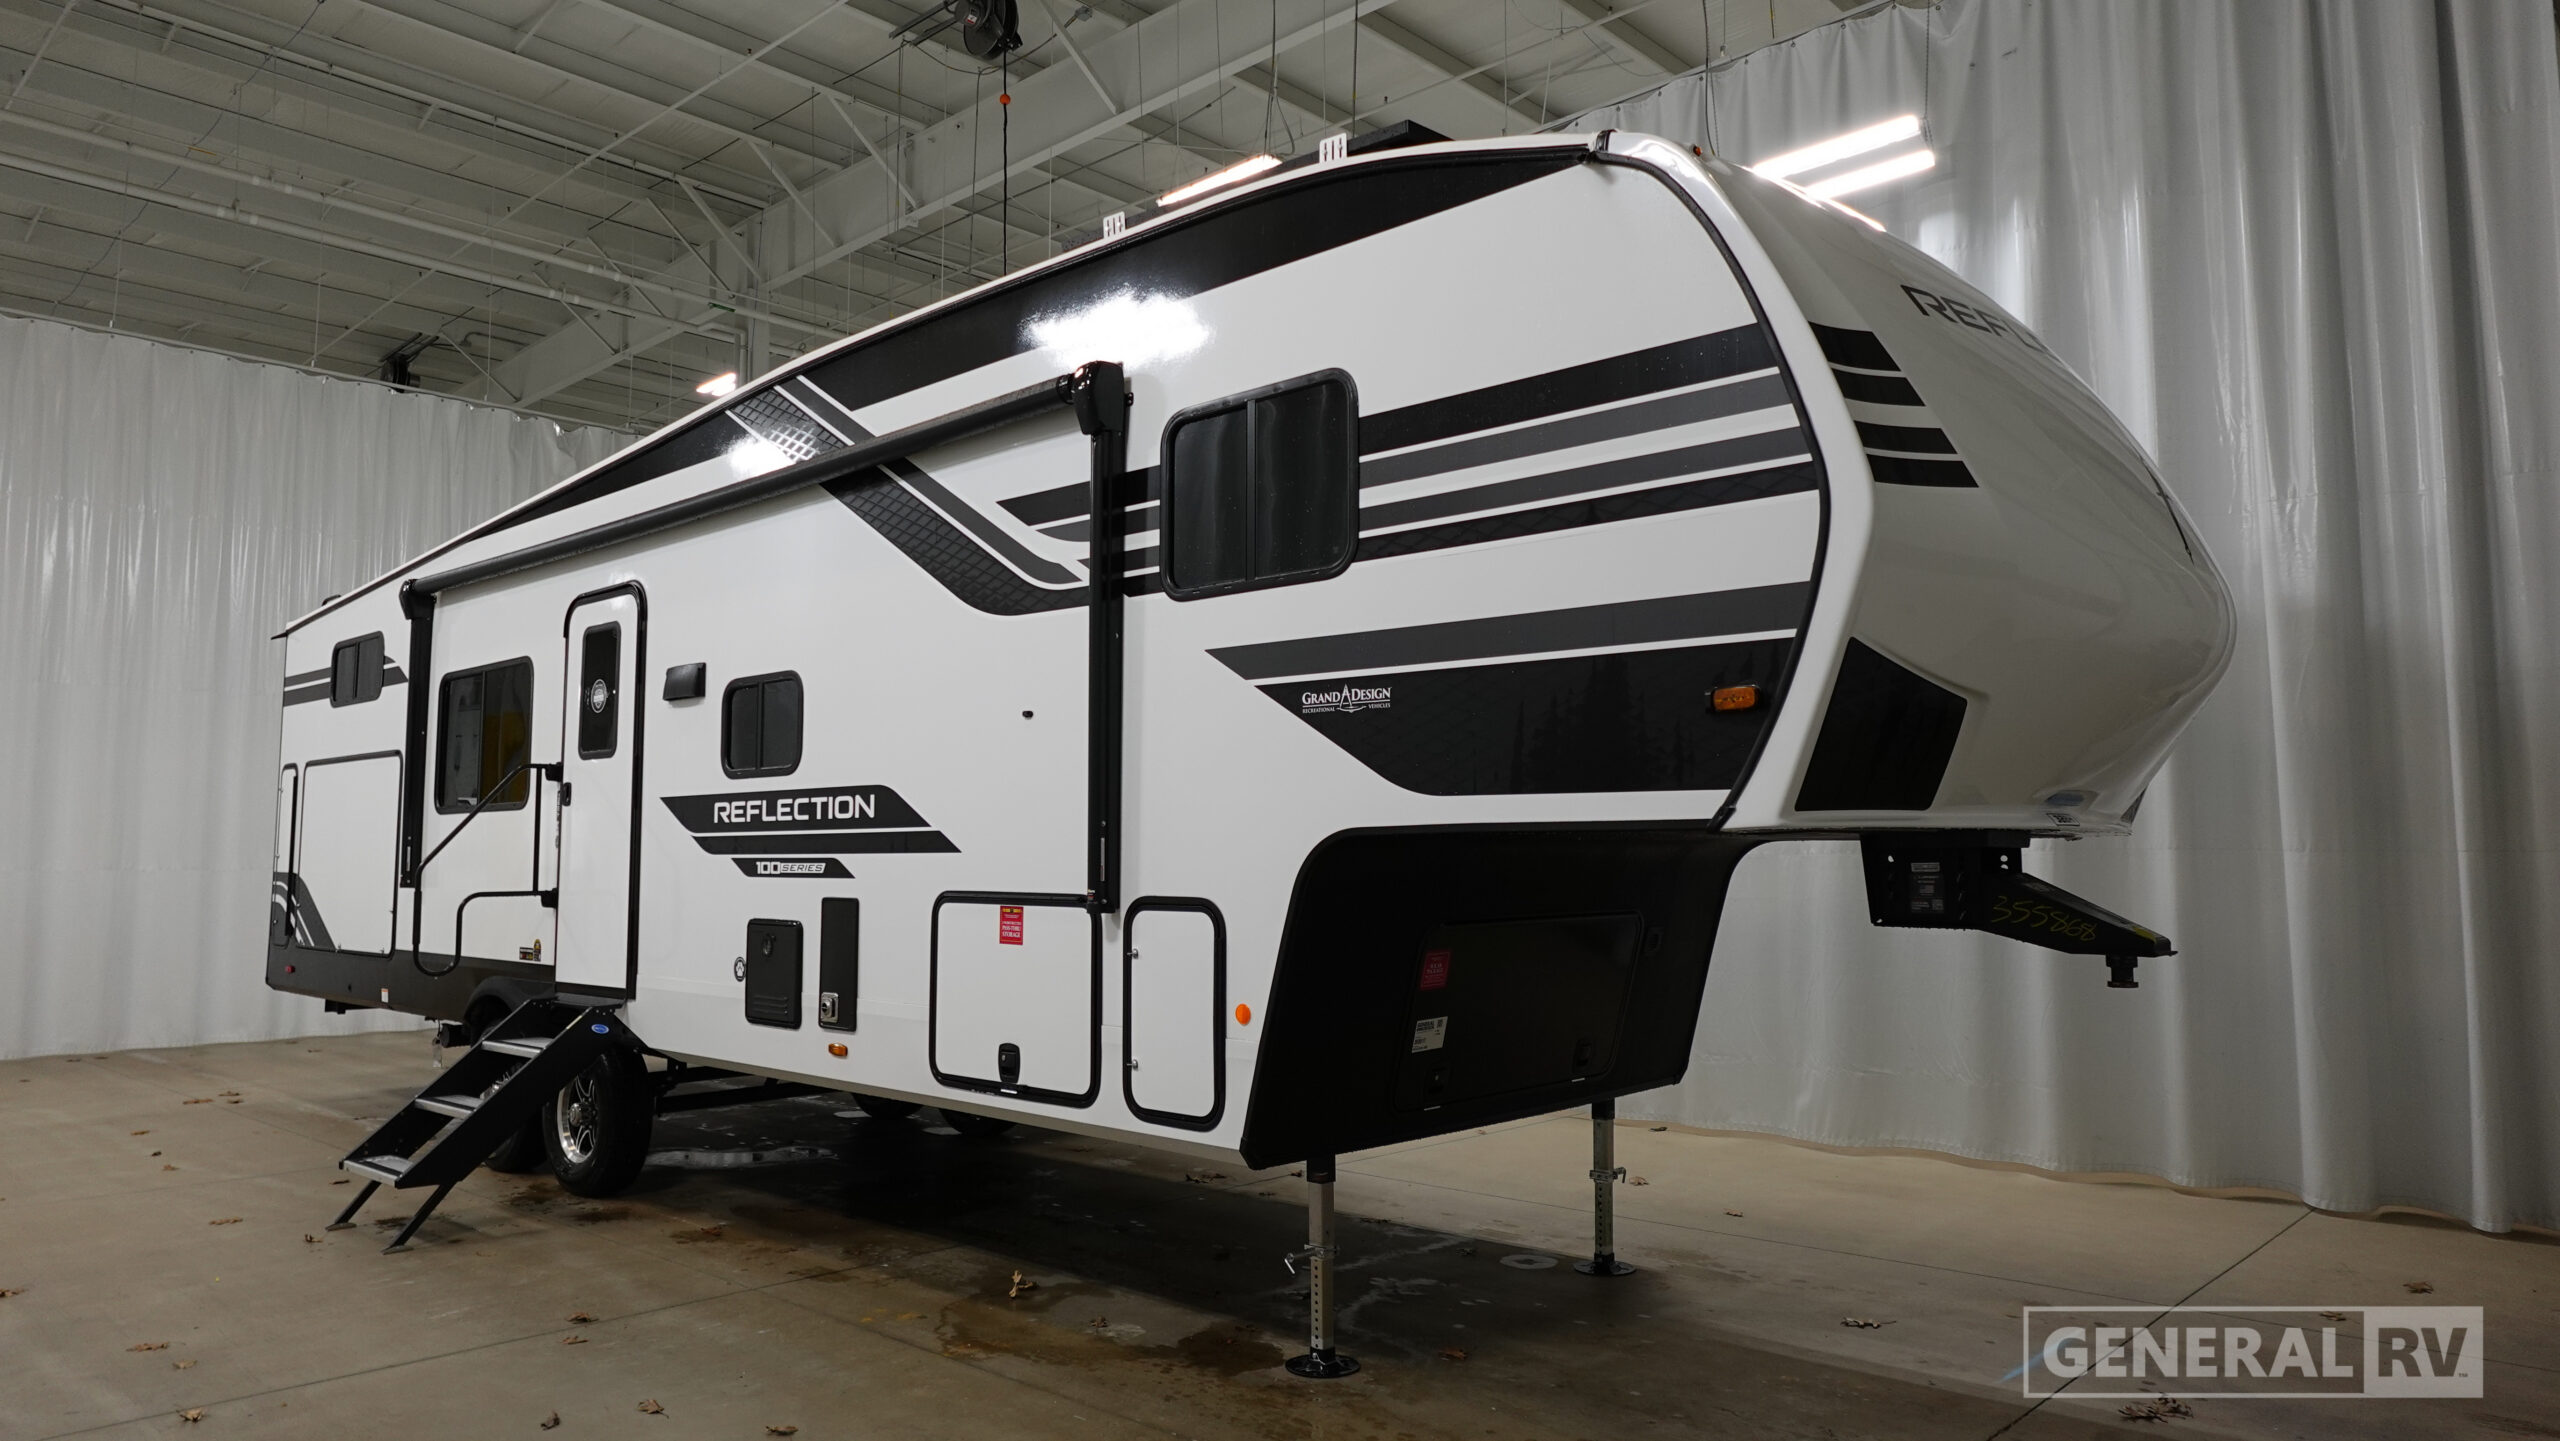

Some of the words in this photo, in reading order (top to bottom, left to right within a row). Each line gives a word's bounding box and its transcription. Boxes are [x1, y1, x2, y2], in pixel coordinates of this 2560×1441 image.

[1301, 691, 1341, 705] GRAND
[1351, 687, 1391, 702] DESIGN
[1302, 706, 1336, 714] RECREATIONAL
[714, 794, 876, 824] REFLECTION
[756, 861, 781, 875] 100
[781, 863, 825, 873] SERIES
